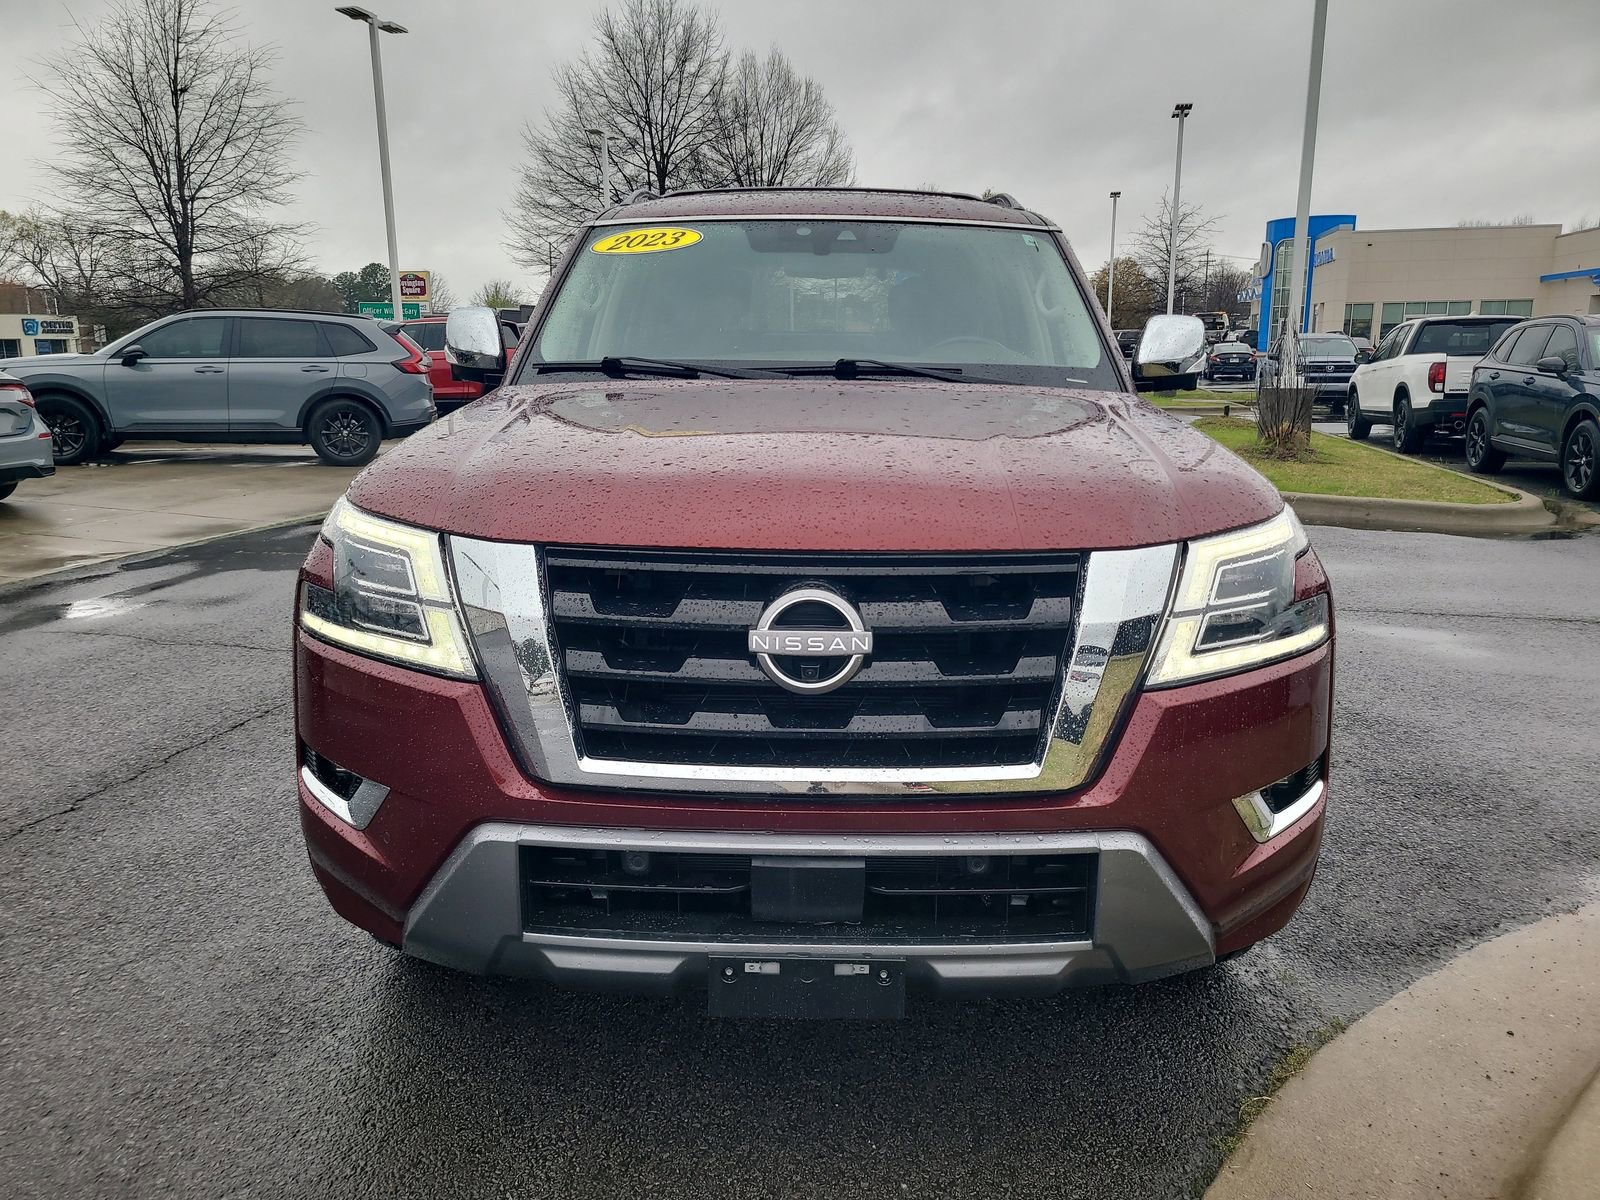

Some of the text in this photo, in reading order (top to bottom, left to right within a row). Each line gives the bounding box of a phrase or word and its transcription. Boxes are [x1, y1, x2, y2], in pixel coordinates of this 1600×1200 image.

[606, 231, 687, 251] 2023
[400, 279, 425, 288] ovington
[752, 635, 869, 651] NISSAN
